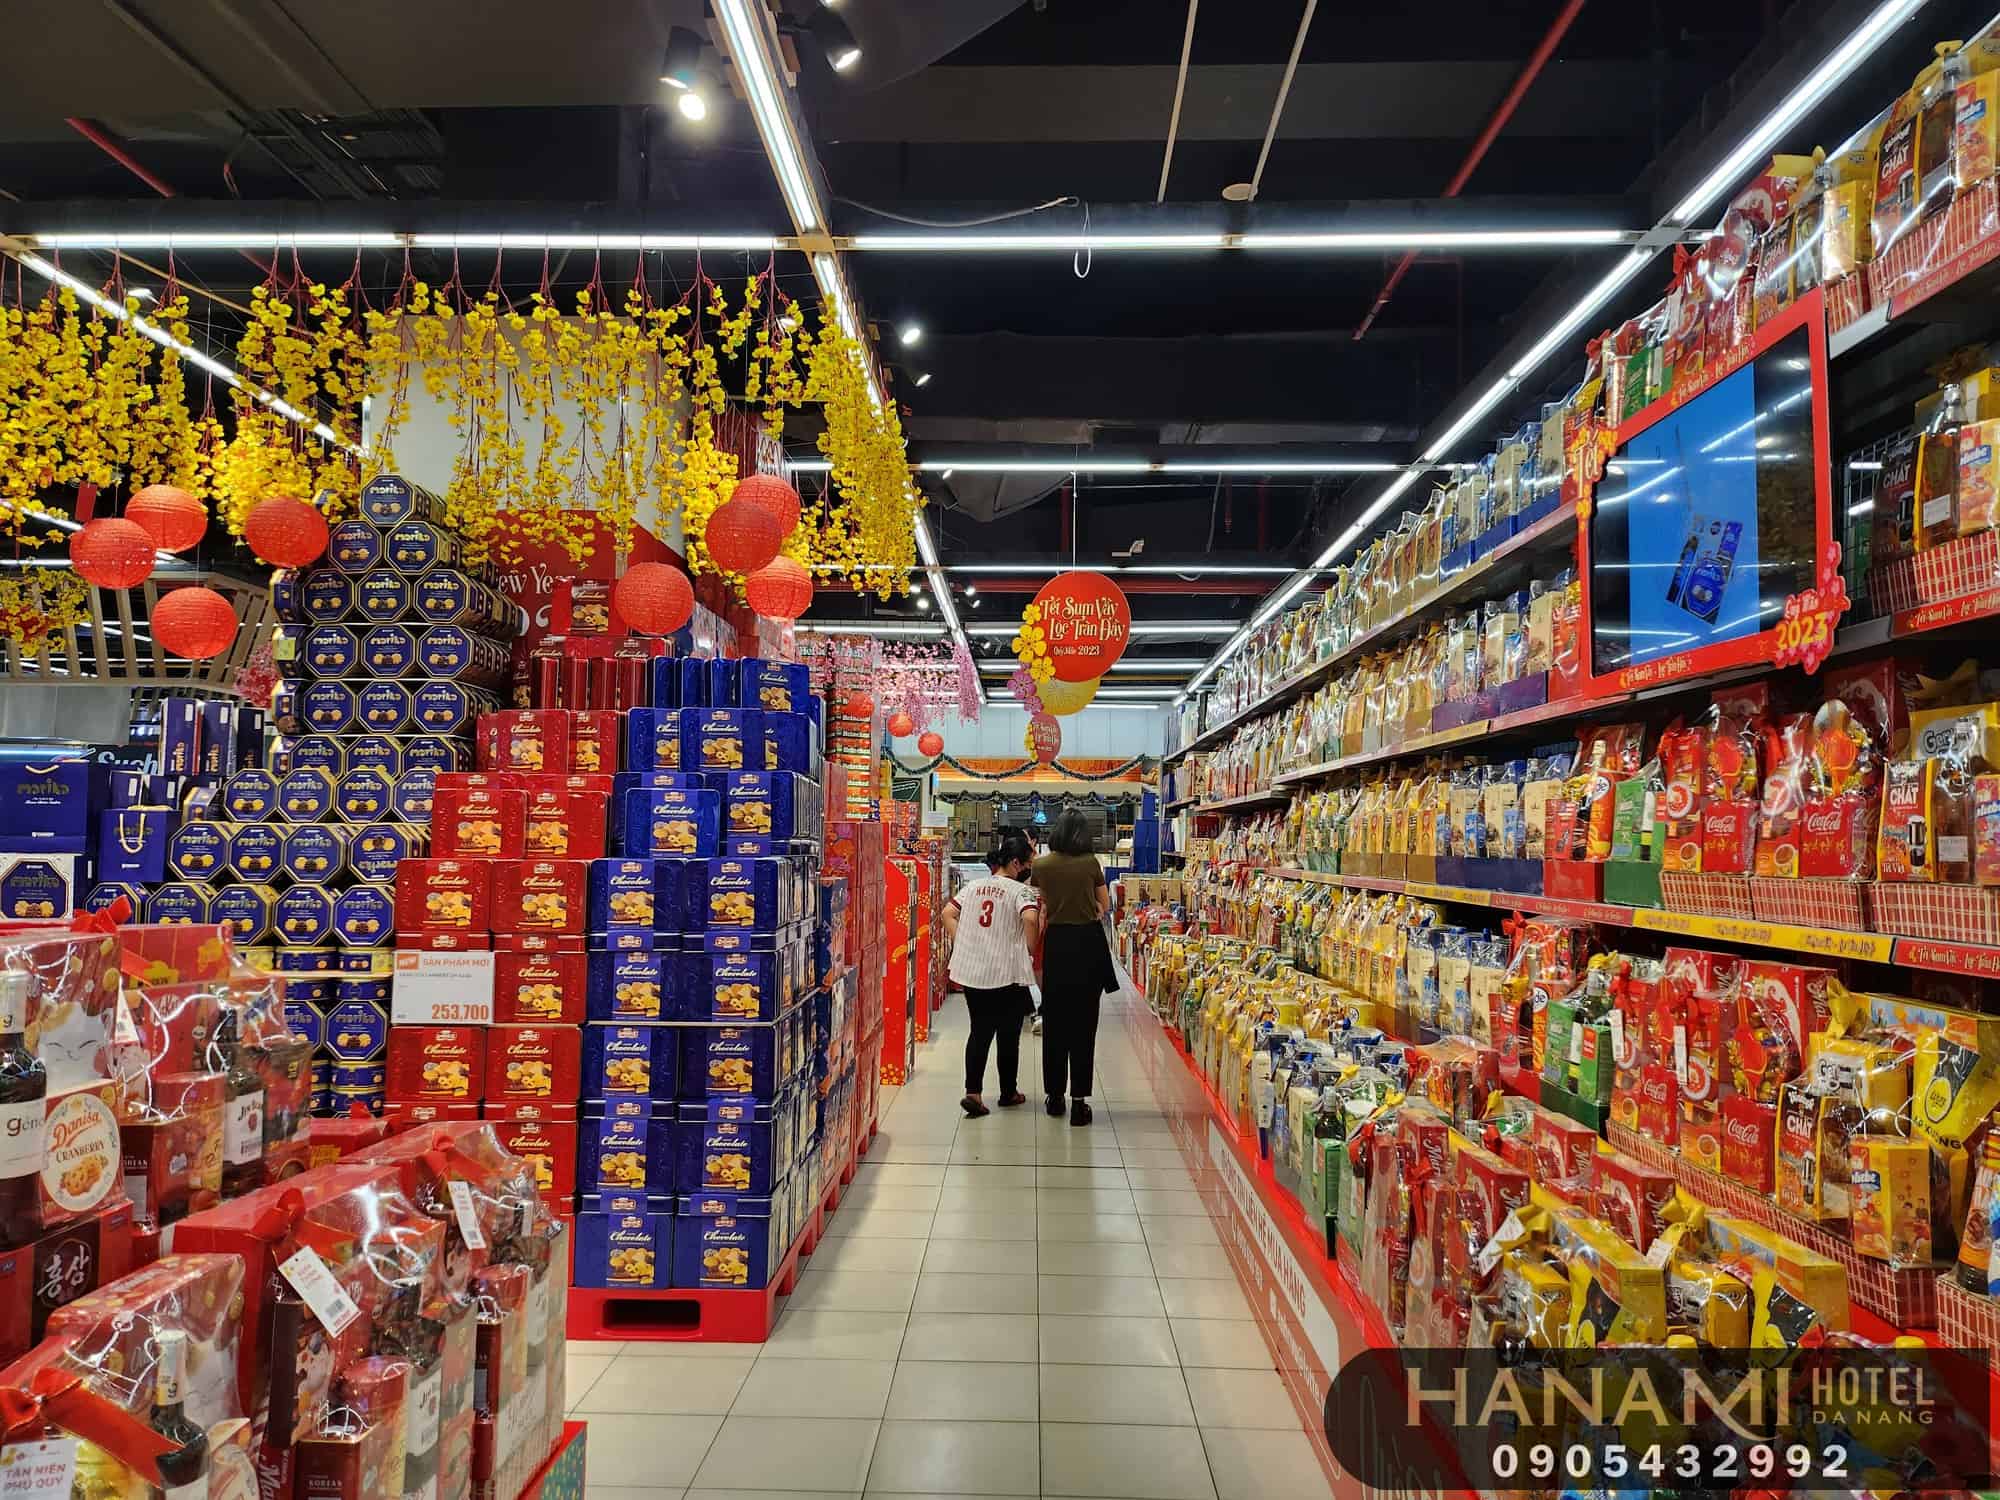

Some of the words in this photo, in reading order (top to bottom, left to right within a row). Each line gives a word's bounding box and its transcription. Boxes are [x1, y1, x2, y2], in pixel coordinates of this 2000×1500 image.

[499, 574, 528, 594] ew
[530, 563, 554, 594] Ye
[1040, 594, 1061, 620] Tết
[1049, 618, 1070, 641] Lộc
[1070, 619, 1097, 641] Tràn
[1099, 617, 1126, 642] Đầy
[1776, 611, 1829, 650] 2023
[1078, 645, 1101, 656] 2023
[976, 886, 1006, 900] HARPER
[979, 900, 994, 928] 3
[50, 1111, 101, 1152] Danisa
[601, 1134, 643, 1146] Chocolate
[56, 1139, 105, 1163] CRANBERRY
[609, 1229, 652, 1242] Chocolate
[704, 1229, 746, 1242] Chocolate
